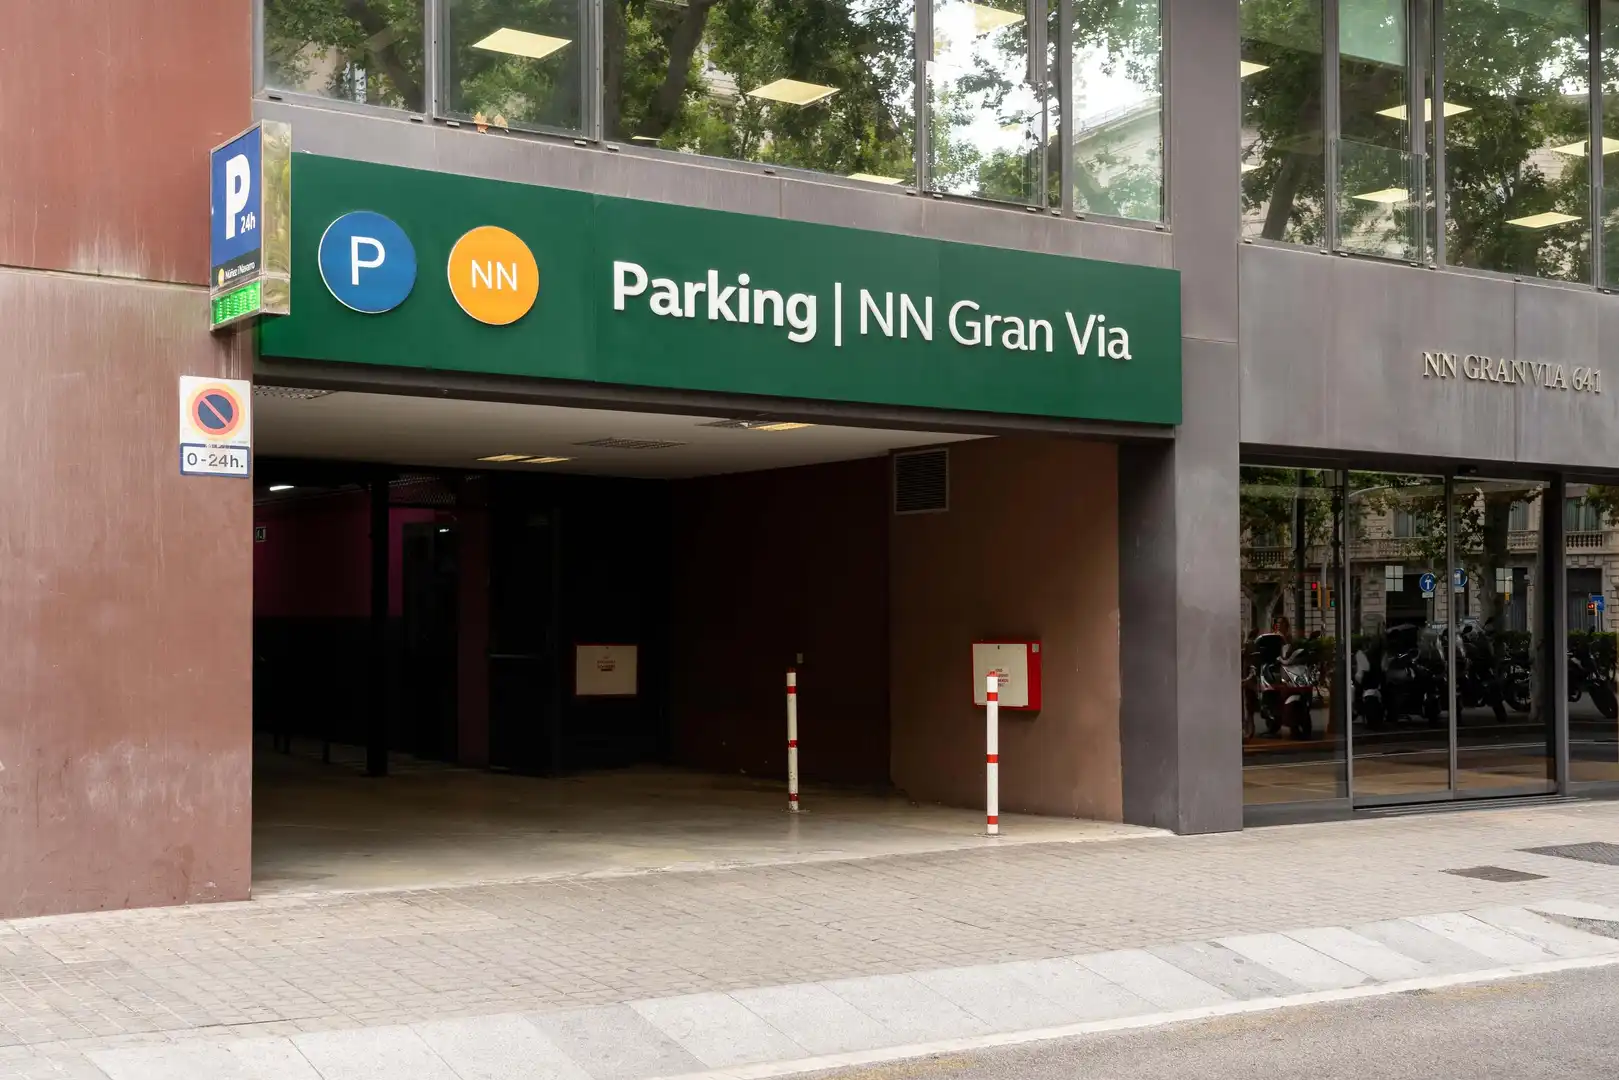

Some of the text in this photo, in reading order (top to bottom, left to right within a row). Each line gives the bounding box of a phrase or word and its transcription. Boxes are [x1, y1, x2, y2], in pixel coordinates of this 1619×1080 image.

[225, 153, 251, 240] P
[240, 211, 256, 234] 24h
[350, 235, 386, 286] P
[471, 259, 518, 291] NN
[612, 260, 818, 344] Parking
[858, 288, 933, 341] NN
[948, 299, 1054, 352] Gran
[1064, 311, 1133, 361] Via
[1422, 351, 1458, 378] NN
[1572, 367, 1602, 394] 641
